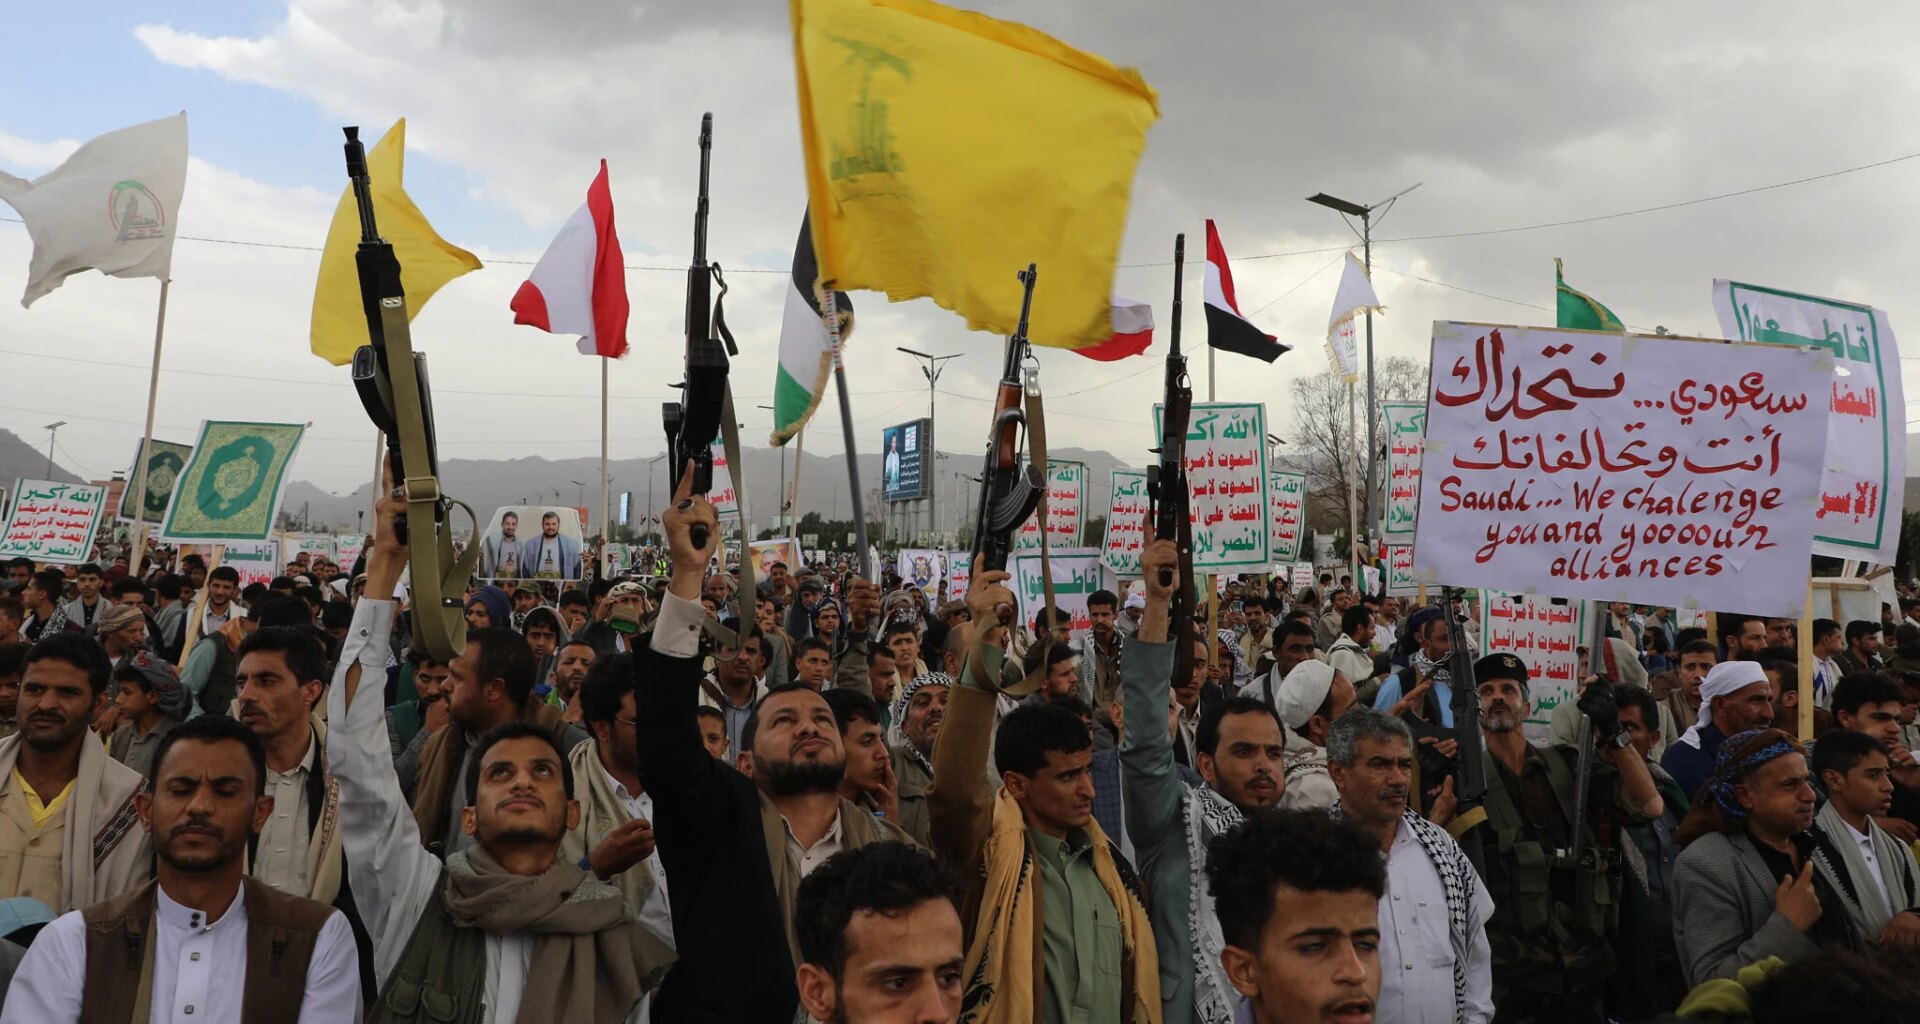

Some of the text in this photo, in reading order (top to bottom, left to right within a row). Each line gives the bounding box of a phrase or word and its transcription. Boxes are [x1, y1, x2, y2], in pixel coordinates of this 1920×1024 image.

[1186, 411, 1258, 440] الله أك
[1218, 450, 1258, 470] الموت
[1683, 424, 1782, 476] أنت
[1056, 466, 1079, 481] الله
[21, 484, 100, 503] الله أكبر
[1053, 489, 1079, 500] الموت
[1188, 477, 1215, 500] لإسرا
[1219, 477, 1260, 497] الموت
[60, 505, 94, 517] الموت
[1053, 506, 1079, 518] الموت
[1228, 503, 1260, 521] اللعنة
[1573, 476, 1616, 512] We
[1623, 479, 1784, 529] chalenge
[56, 518, 90, 531] الموت
[1204, 505, 1224, 526] على
[43, 543, 82, 556] النصر
[1219, 526, 1262, 557] النصر
[1273, 542, 1295, 555] النص
[1551, 548, 1724, 581] alliances
[1491, 598, 1577, 625] الموت لأمريكا
[1490, 629, 1575, 655] الموت لإسرائيل
[1546, 660, 1574, 680] اللعنة
